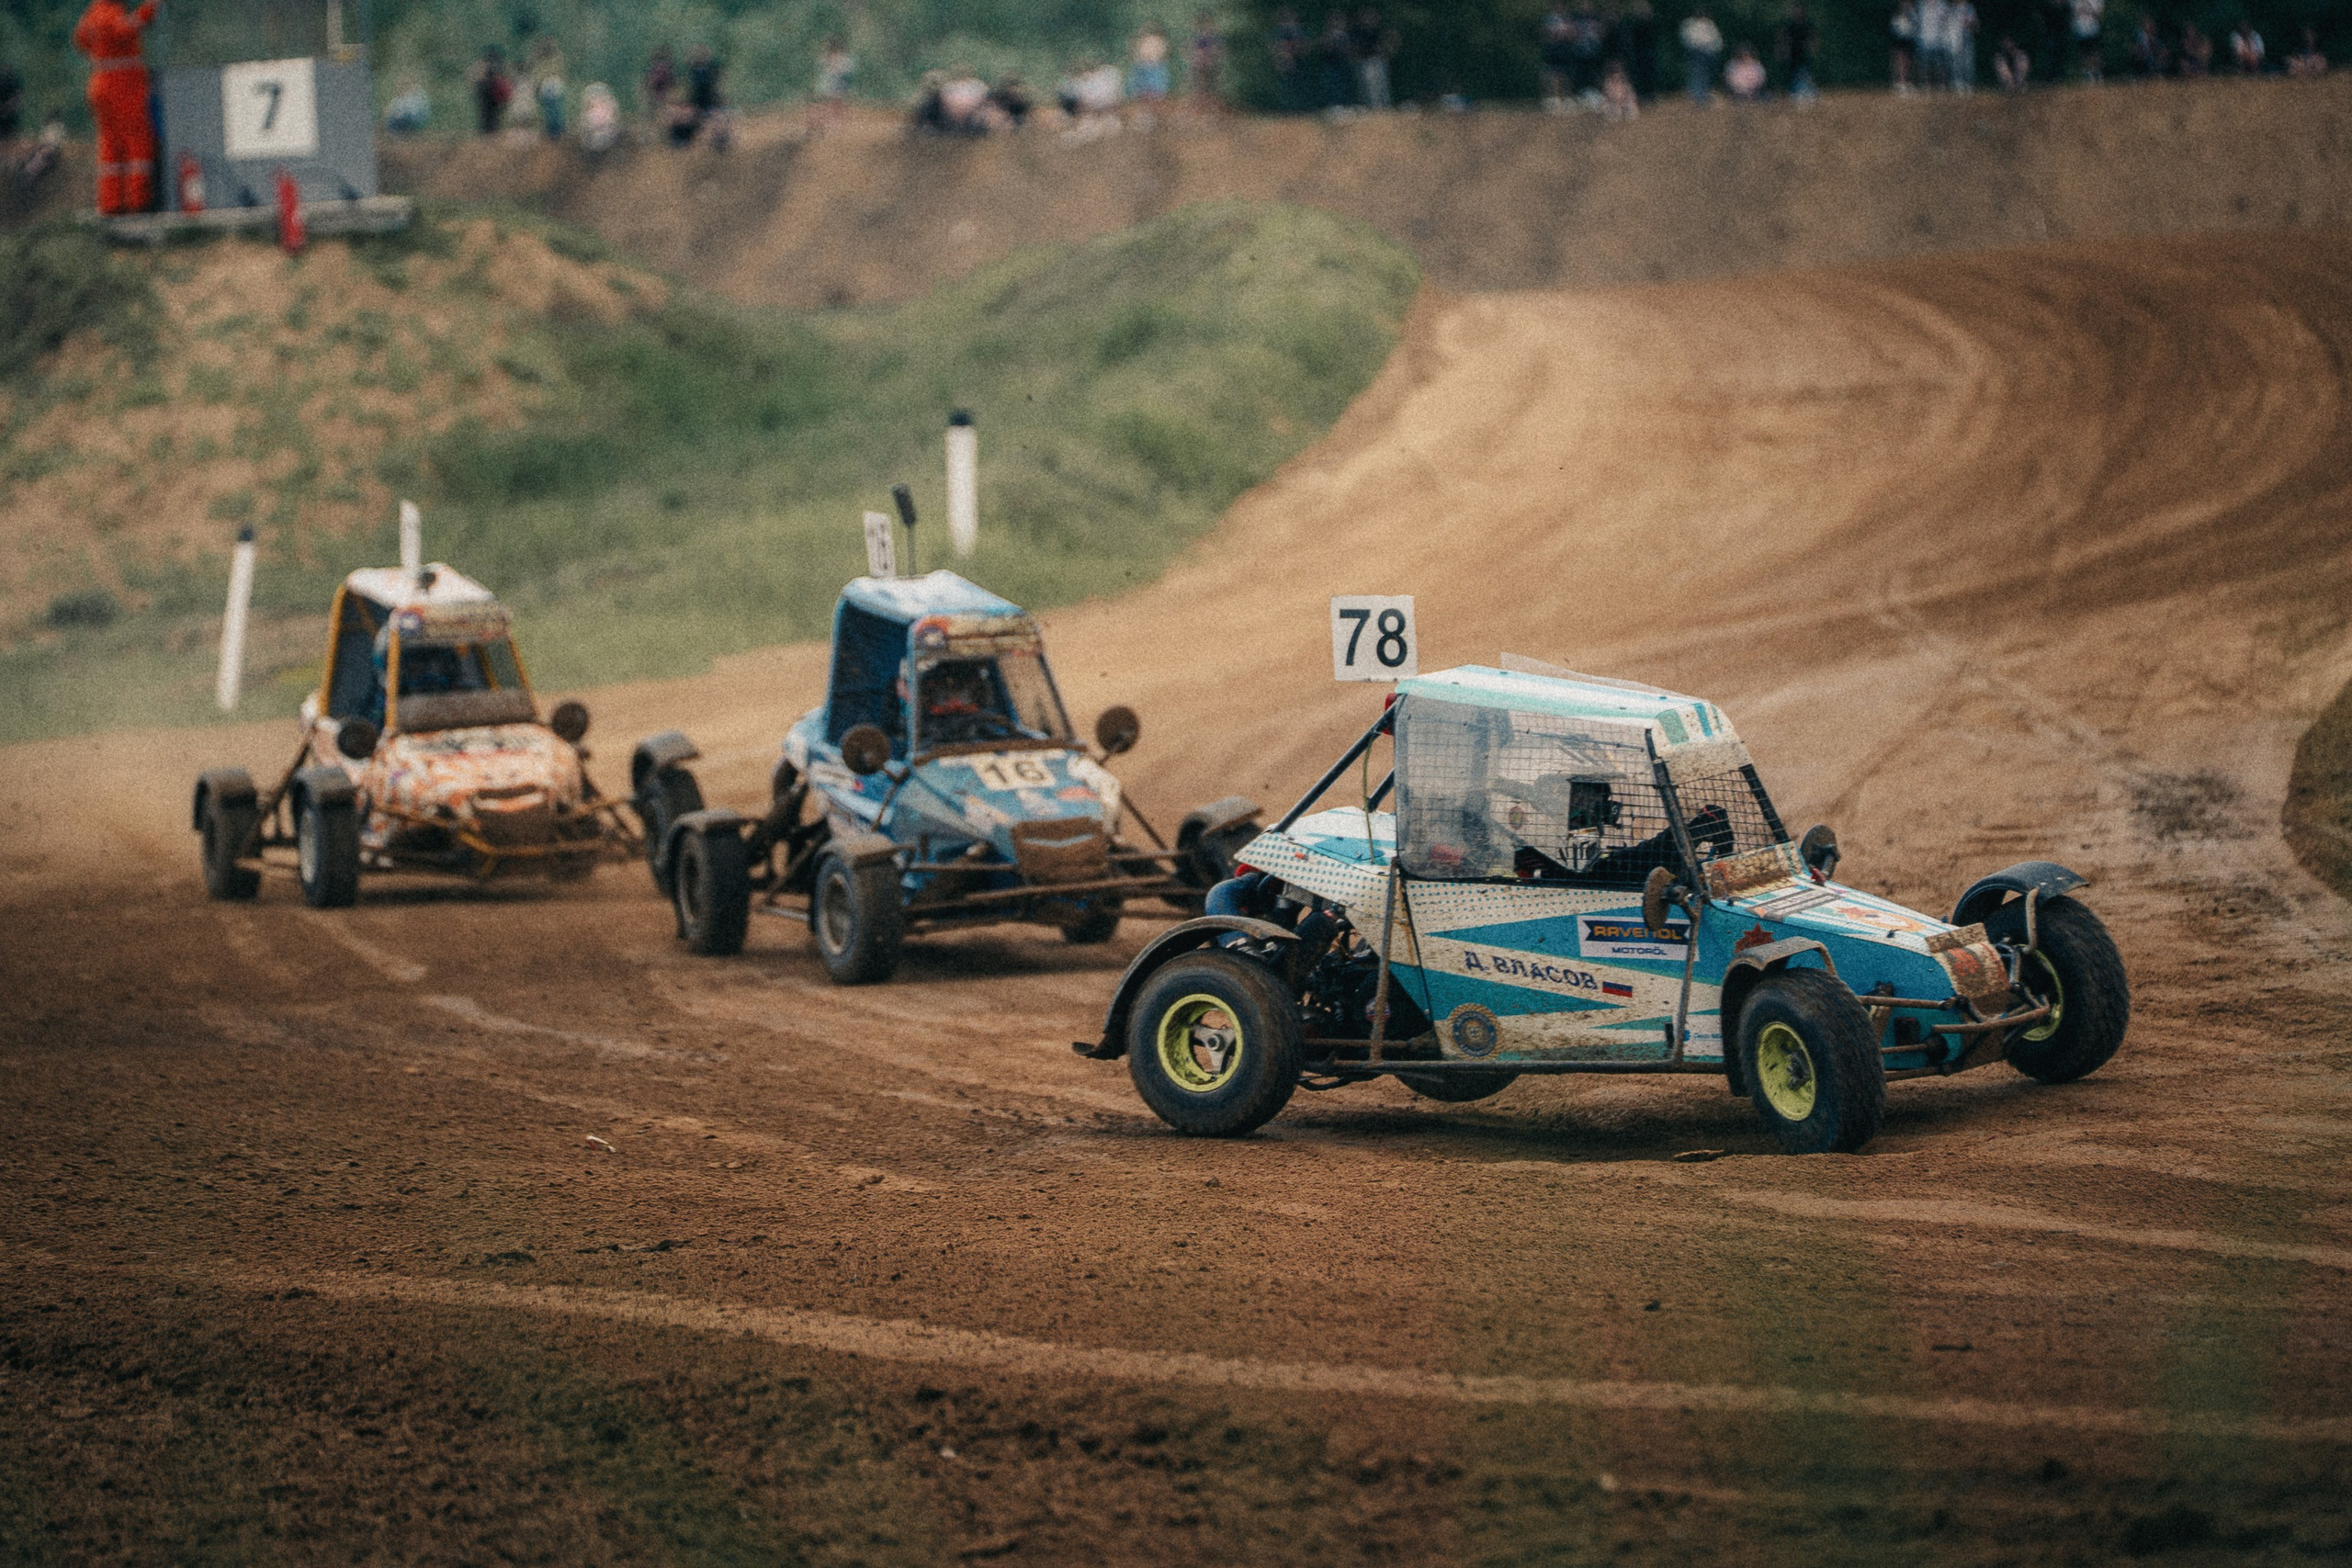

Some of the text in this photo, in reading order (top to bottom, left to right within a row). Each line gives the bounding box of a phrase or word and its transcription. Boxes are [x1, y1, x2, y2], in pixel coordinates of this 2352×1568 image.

[251, 79, 284, 130] 7
[1340, 608, 1408, 668] 78
[984, 761, 1045, 784] 16
[1611, 945, 1668, 956] MOTORÖL
[1492, 955, 1598, 990] ВЛАСОВ
